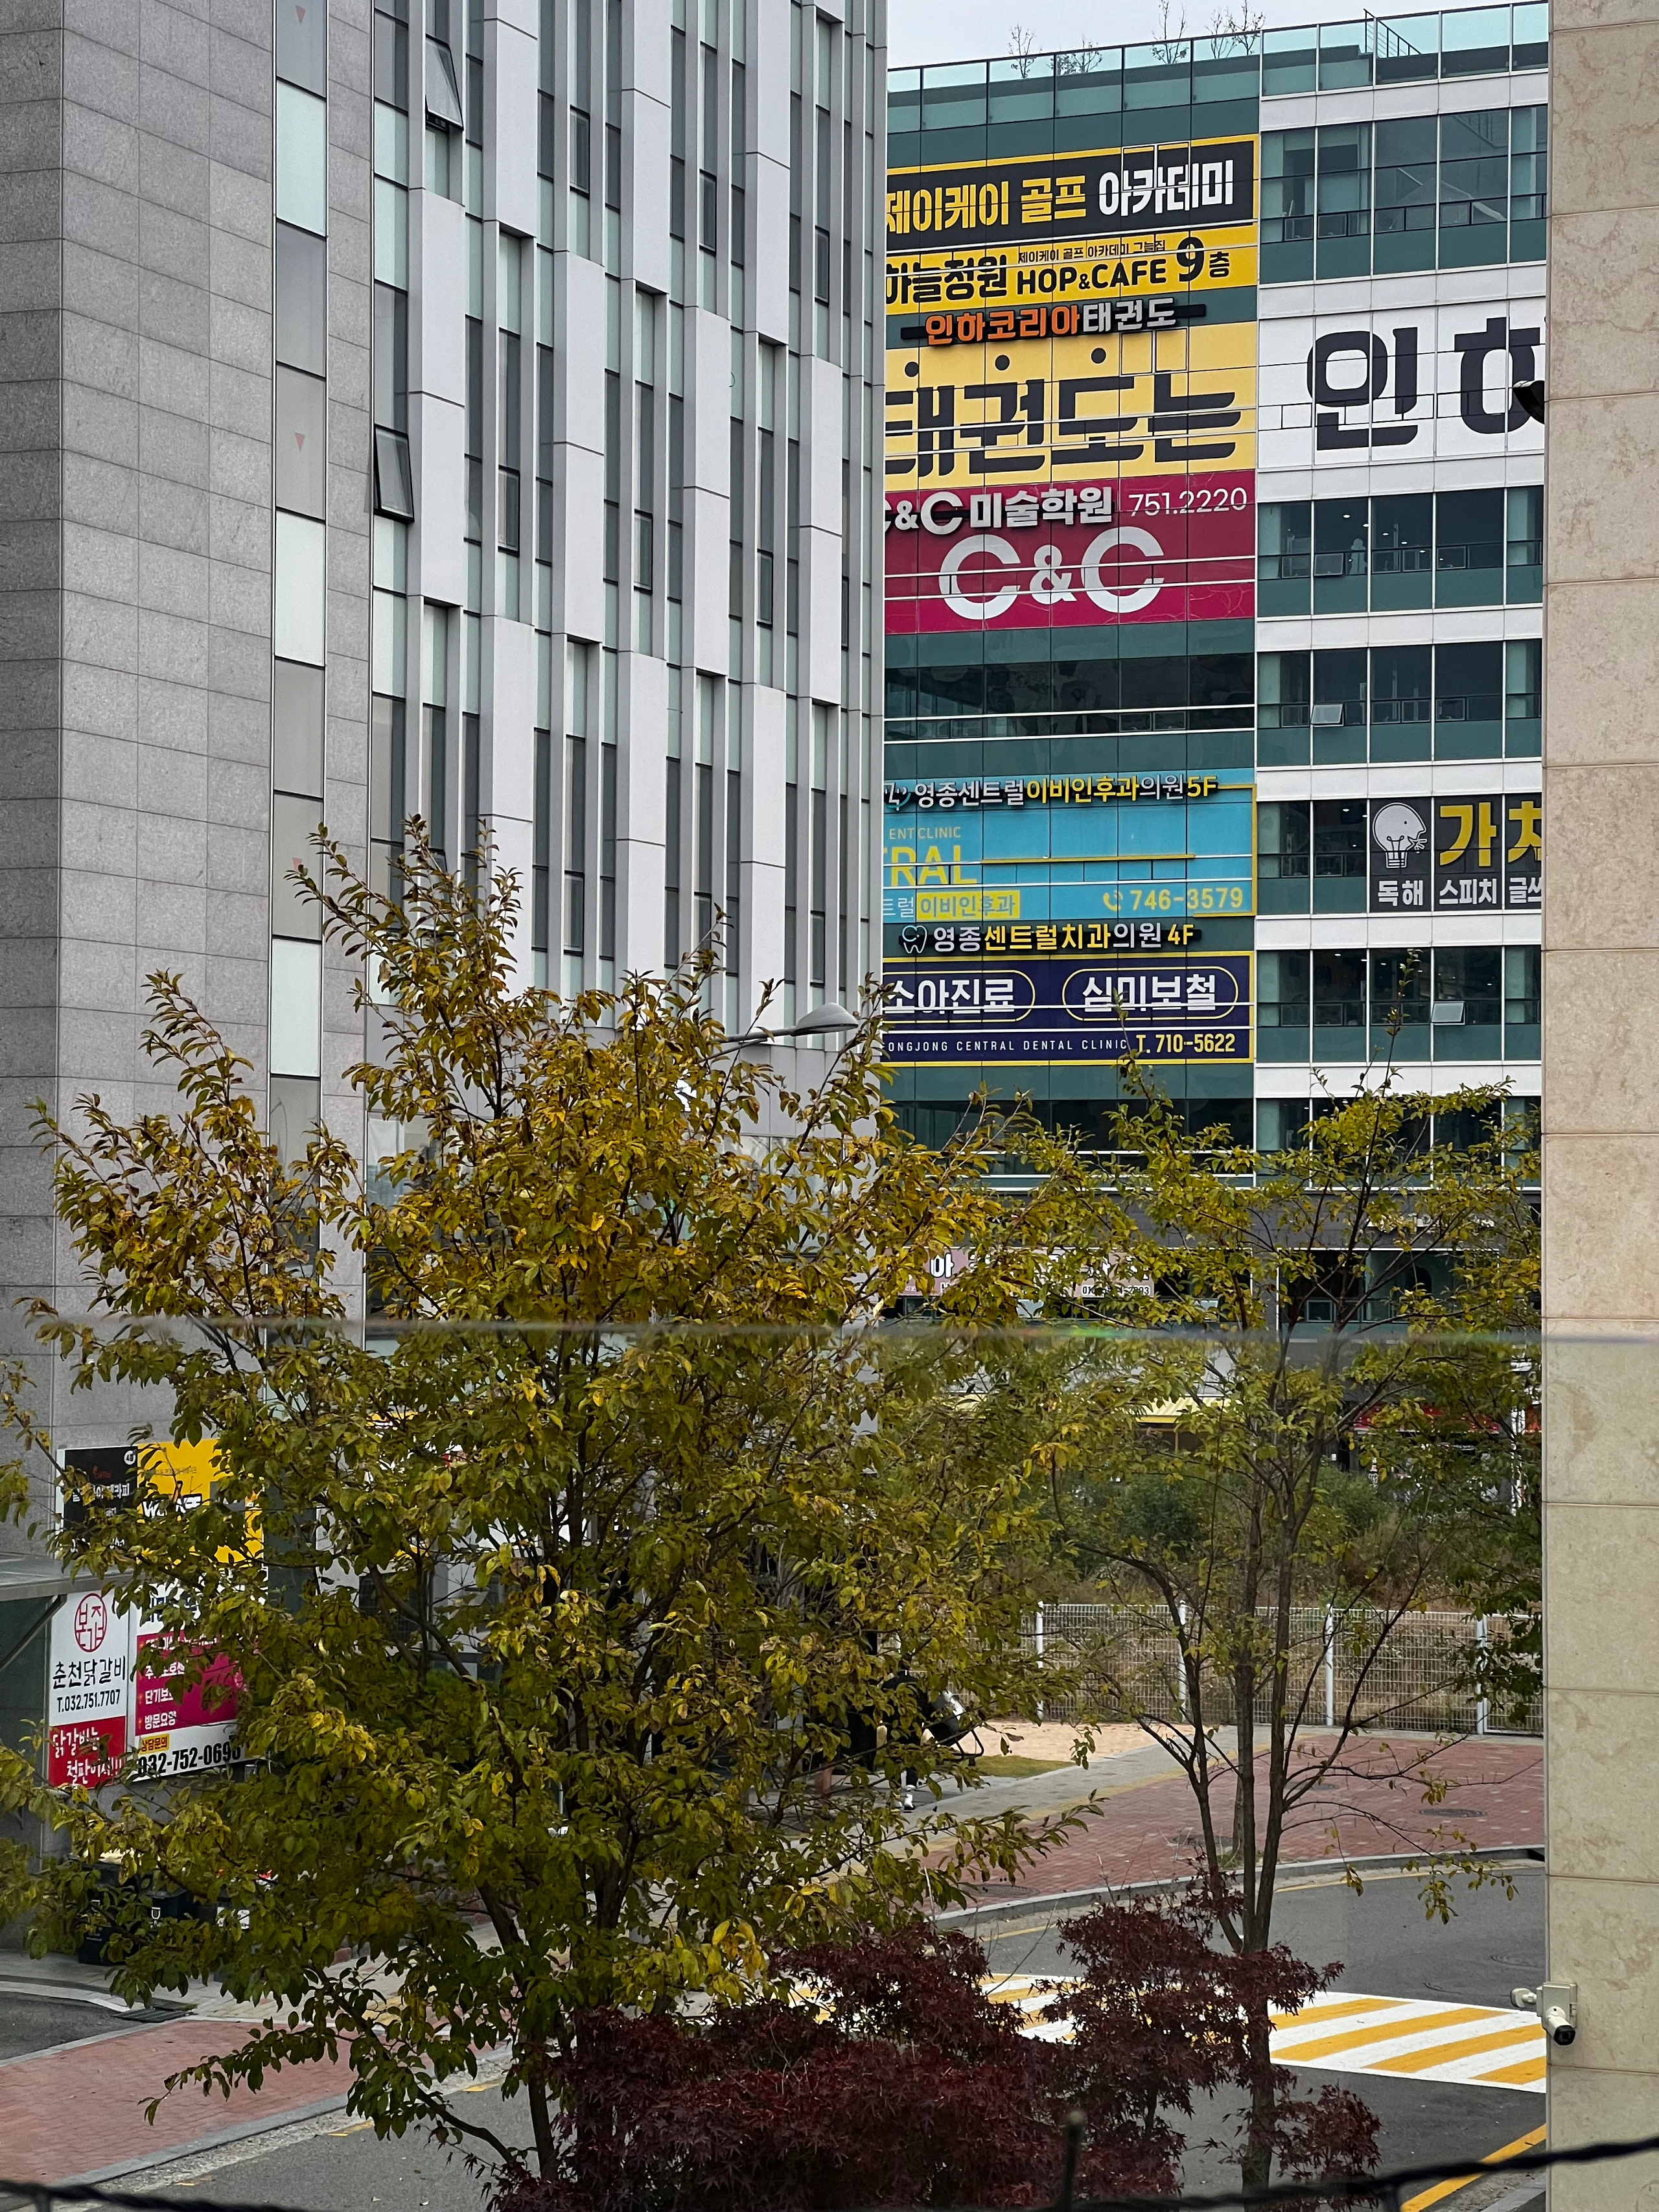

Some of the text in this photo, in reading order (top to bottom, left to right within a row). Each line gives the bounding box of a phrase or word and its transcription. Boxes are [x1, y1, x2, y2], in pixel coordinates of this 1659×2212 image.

[887, 159, 1234, 234] 제이케이 골프 아카데미
[1019, 239, 1166, 264] 제이케이 골프 아카데미 그늘집
[1017, 259, 1166, 295] HOP&CAFE
[925, 297, 1176, 345] 인하코리아태권도
[1128, 487, 1247, 517] 751.2220
[938, 526, 1165, 620] C&C
[917, 826, 962, 839] CLINIC
[883, 844, 978, 887] RAL
[920, 894, 1015, 918] 이비인후과
[1130, 887, 1244, 911] 746-3579
[1378, 879, 1423, 906] 독해
[1439, 878, 1497, 905] 스피치
[1082, 973, 1216, 1012] 심미보철
[956, 1041, 1015, 1051] CENTRAL
[1023, 1040, 1073, 1051] DENTAL
[1081, 1039, 1128, 1050] CLINIC
[52, 1655, 126, 1690] 춘천닭갈비
[144, 1710, 177, 1730] 방문요양
